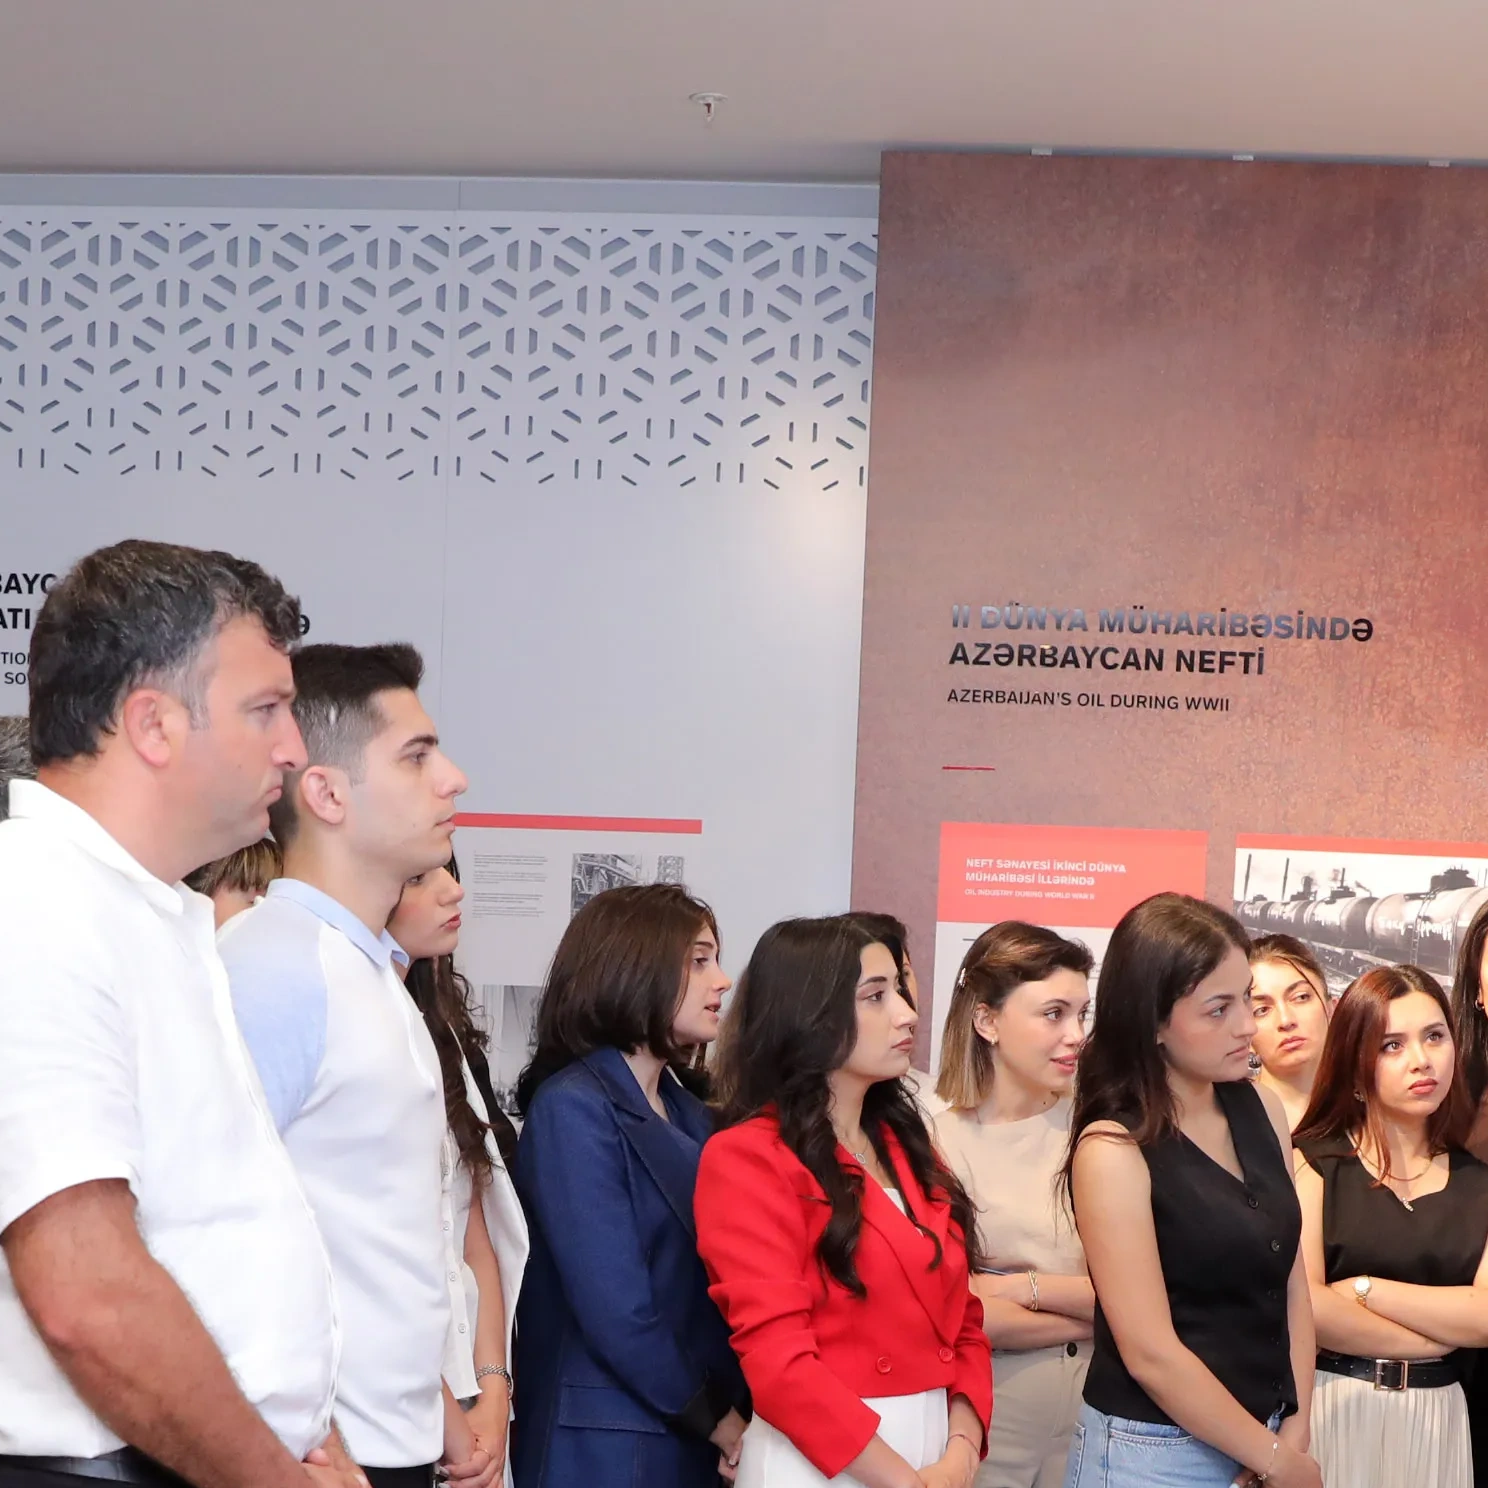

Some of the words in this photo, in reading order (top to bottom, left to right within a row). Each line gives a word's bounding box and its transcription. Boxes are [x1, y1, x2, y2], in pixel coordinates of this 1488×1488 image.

[952, 604, 970, 628] II
[981, 602, 1089, 632] DÜNYA
[1099, 605, 1373, 642] MÜHARİBƏSİNDƏ
[949, 642, 1164, 671] AZƏRBAYCAN
[1176, 647, 1264, 675] NEFTİ
[4, 672, 26, 685] SO
[947, 689, 1072, 706] AZERBAIJAN'S
[1077, 693, 1105, 707] OIL
[1111, 694, 1179, 710] DURING
[1185, 696, 1229, 711] WWII
[966, 858, 994, 869] NEFT
[996, 858, 1051, 870] SƏNAYESİ
[1089, 862, 1127, 874] DÜNYA
